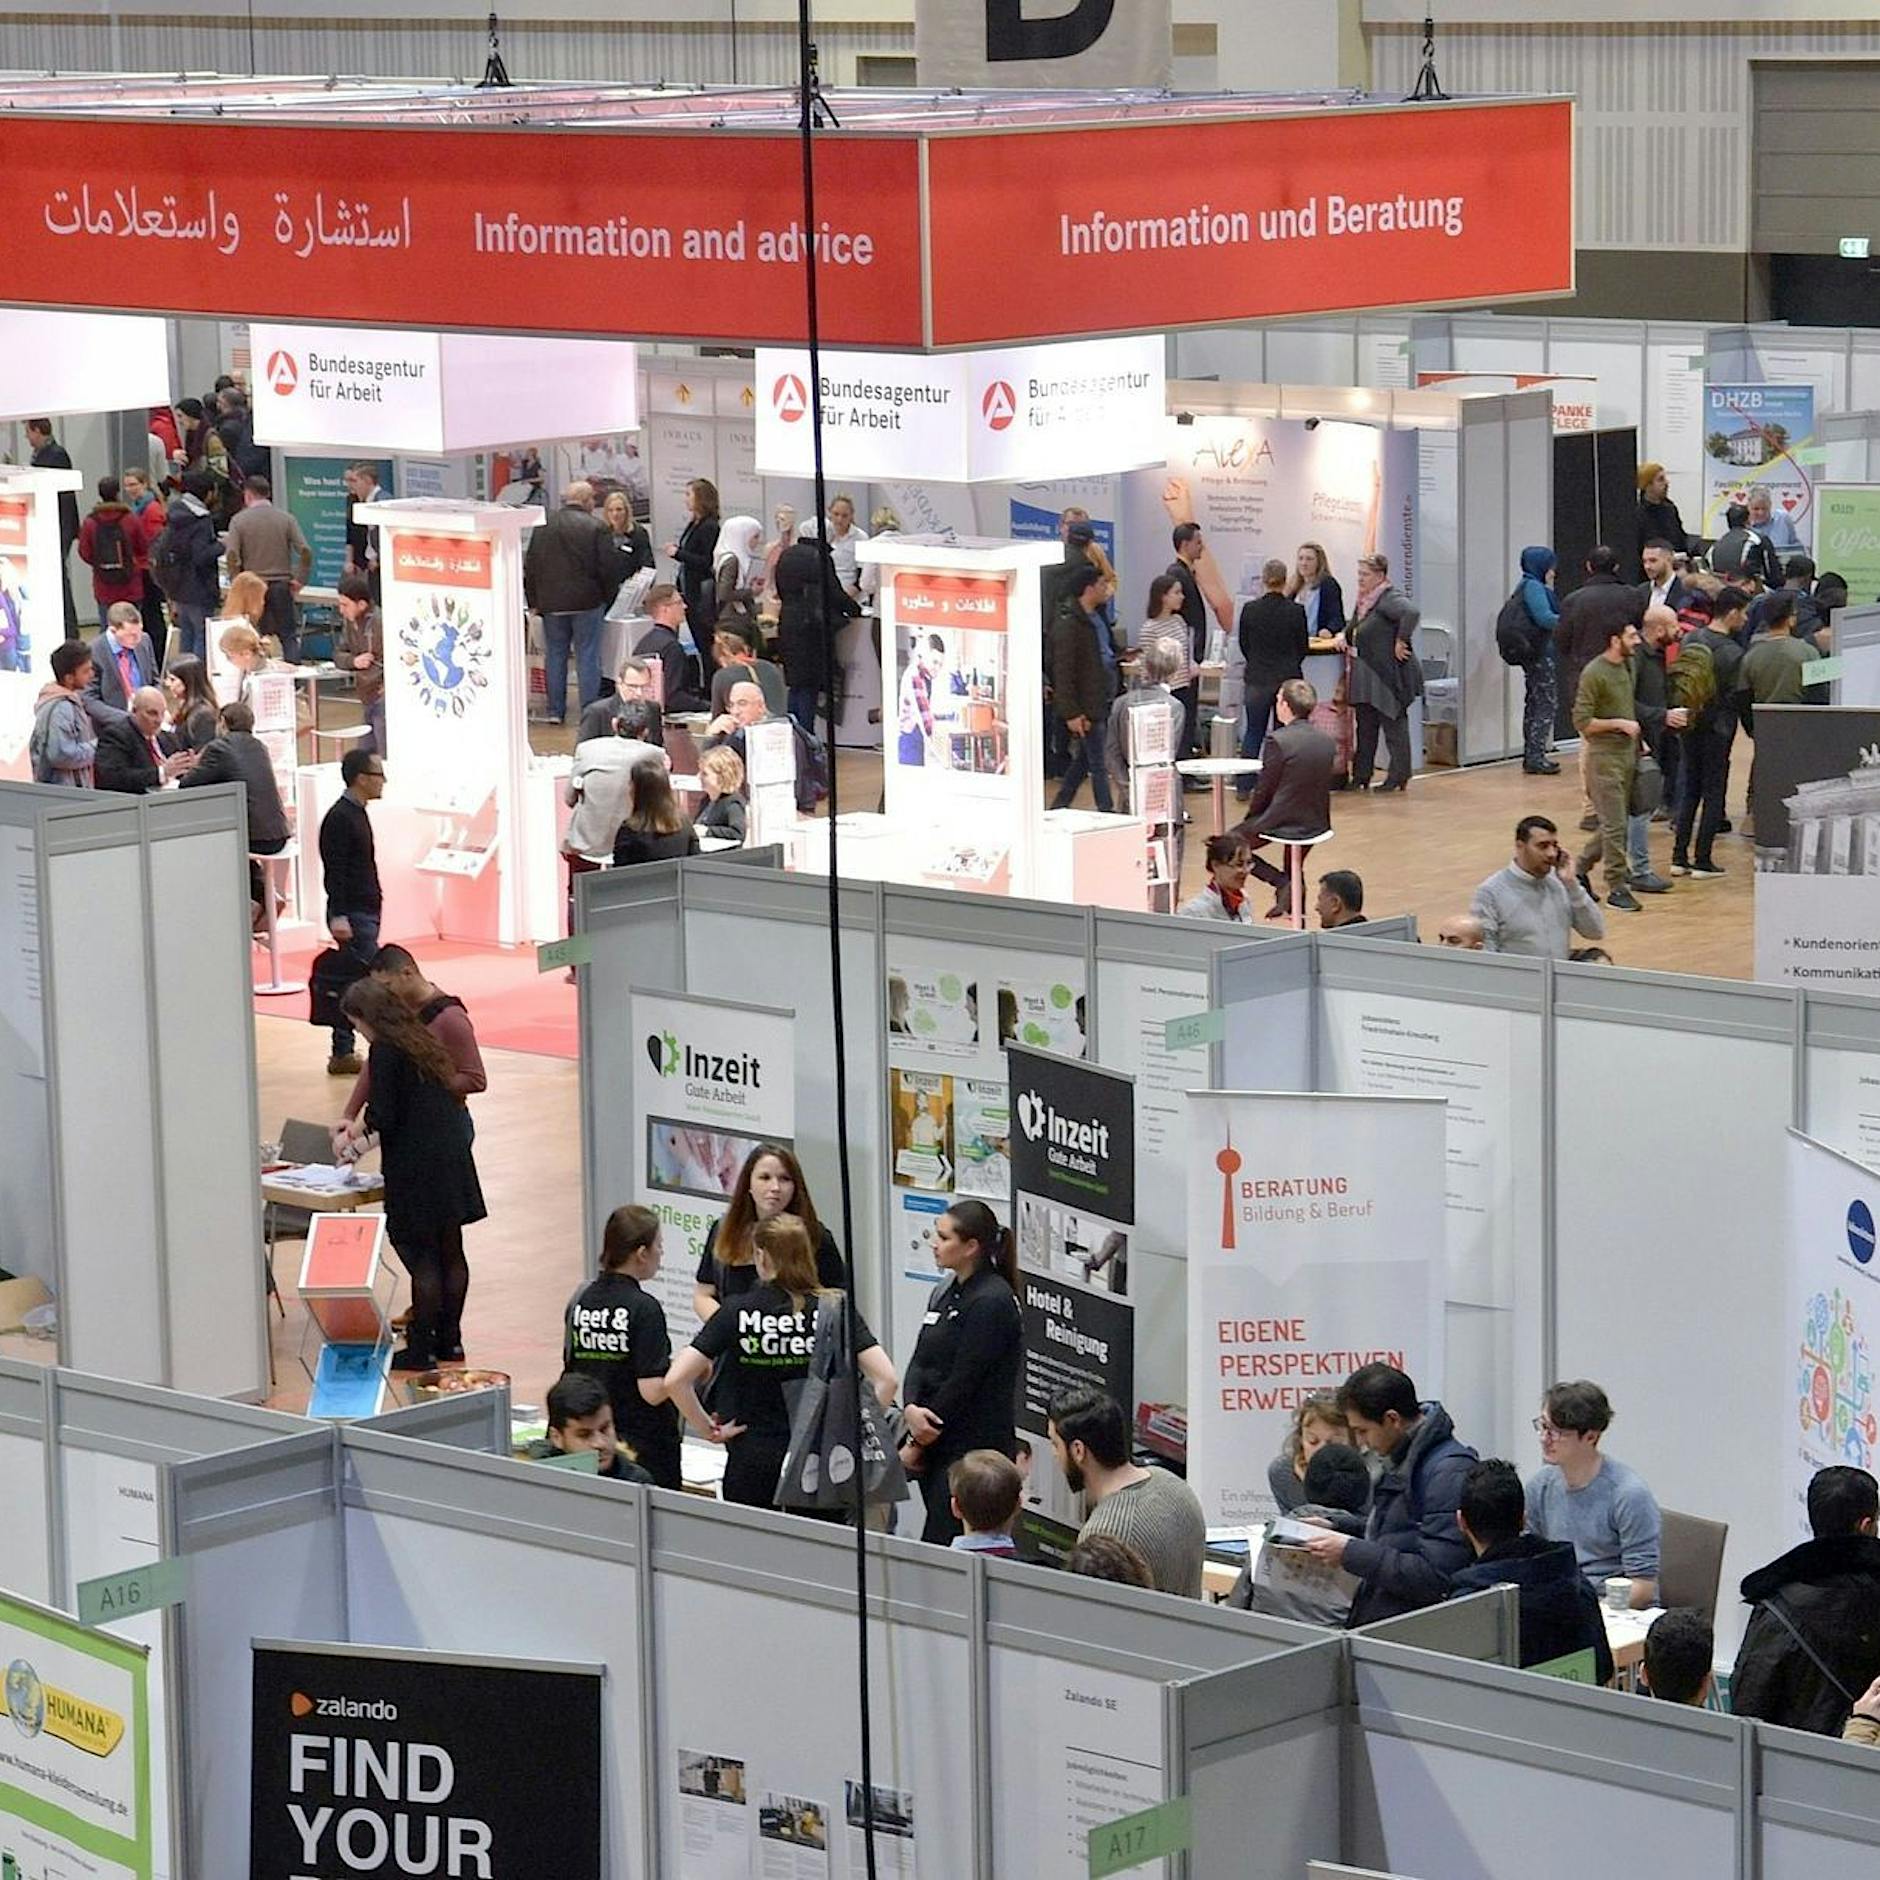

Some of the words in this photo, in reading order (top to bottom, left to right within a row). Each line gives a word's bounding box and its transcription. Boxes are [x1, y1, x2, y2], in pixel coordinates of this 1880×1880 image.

[45, 183, 240, 254] واستعلامات
[273, 191, 410, 257] استشارة
[1061, 205, 1249, 256] Information
[1259, 198, 1316, 242] und
[1328, 193, 1463, 236] Beratung
[475, 213, 670, 258] Information
[683, 221, 745, 261] and
[309, 353, 425, 380] Bundesagentur
[310, 379, 331, 399] für
[336, 383, 382, 402] Arbeit
[820, 378, 951, 406] Bundesagentur
[1712, 391, 1763, 408] DHZB
[820, 405, 845, 426] für
[849, 408, 901, 430] Arbeit
[1178, 1023, 1200, 1040] A46
[685, 1044, 760, 1088] Inzeit
[685, 1083, 710, 1099] Gute
[712, 1088, 745, 1105] Arbeit
[1048, 1107, 1109, 1159] Inzeit
[1048, 1148, 1067, 1166] Gute
[1069, 1155, 1097, 1176] Arbeit
[1241, 1177, 1347, 1199] BERATUNG
[652, 1204, 700, 1232] Pflege
[1243, 1205, 1304, 1224] Bildung
[1310, 1203, 1321, 1219] &
[1328, 1201, 1374, 1219] Beruf
[1026, 1285, 1061, 1315] Hotel
[1063, 1297, 1074, 1320] &
[611, 1307, 629, 1331] &
[739, 1310, 806, 1333] Meet
[1219, 1320, 1306, 1343] EIGENE
[580, 1327, 630, 1352] Greet
[761, 1333, 816, 1355] Gree
[1046, 1318, 1109, 1364] Reinigung
[118, 1486, 154, 1502] HUMANA
[100, 1582, 142, 1612] A16
[316, 1696, 397, 1720] zalando
[1065, 1690, 1102, 1707] Zalando
[1105, 1699, 1117, 1711] SE
[47, 1696, 106, 1736] HUMANA
[290, 1733, 455, 1804] FIND
[286, 1804, 493, 1880] YOUR
[1109, 1827, 1145, 1860] A17
